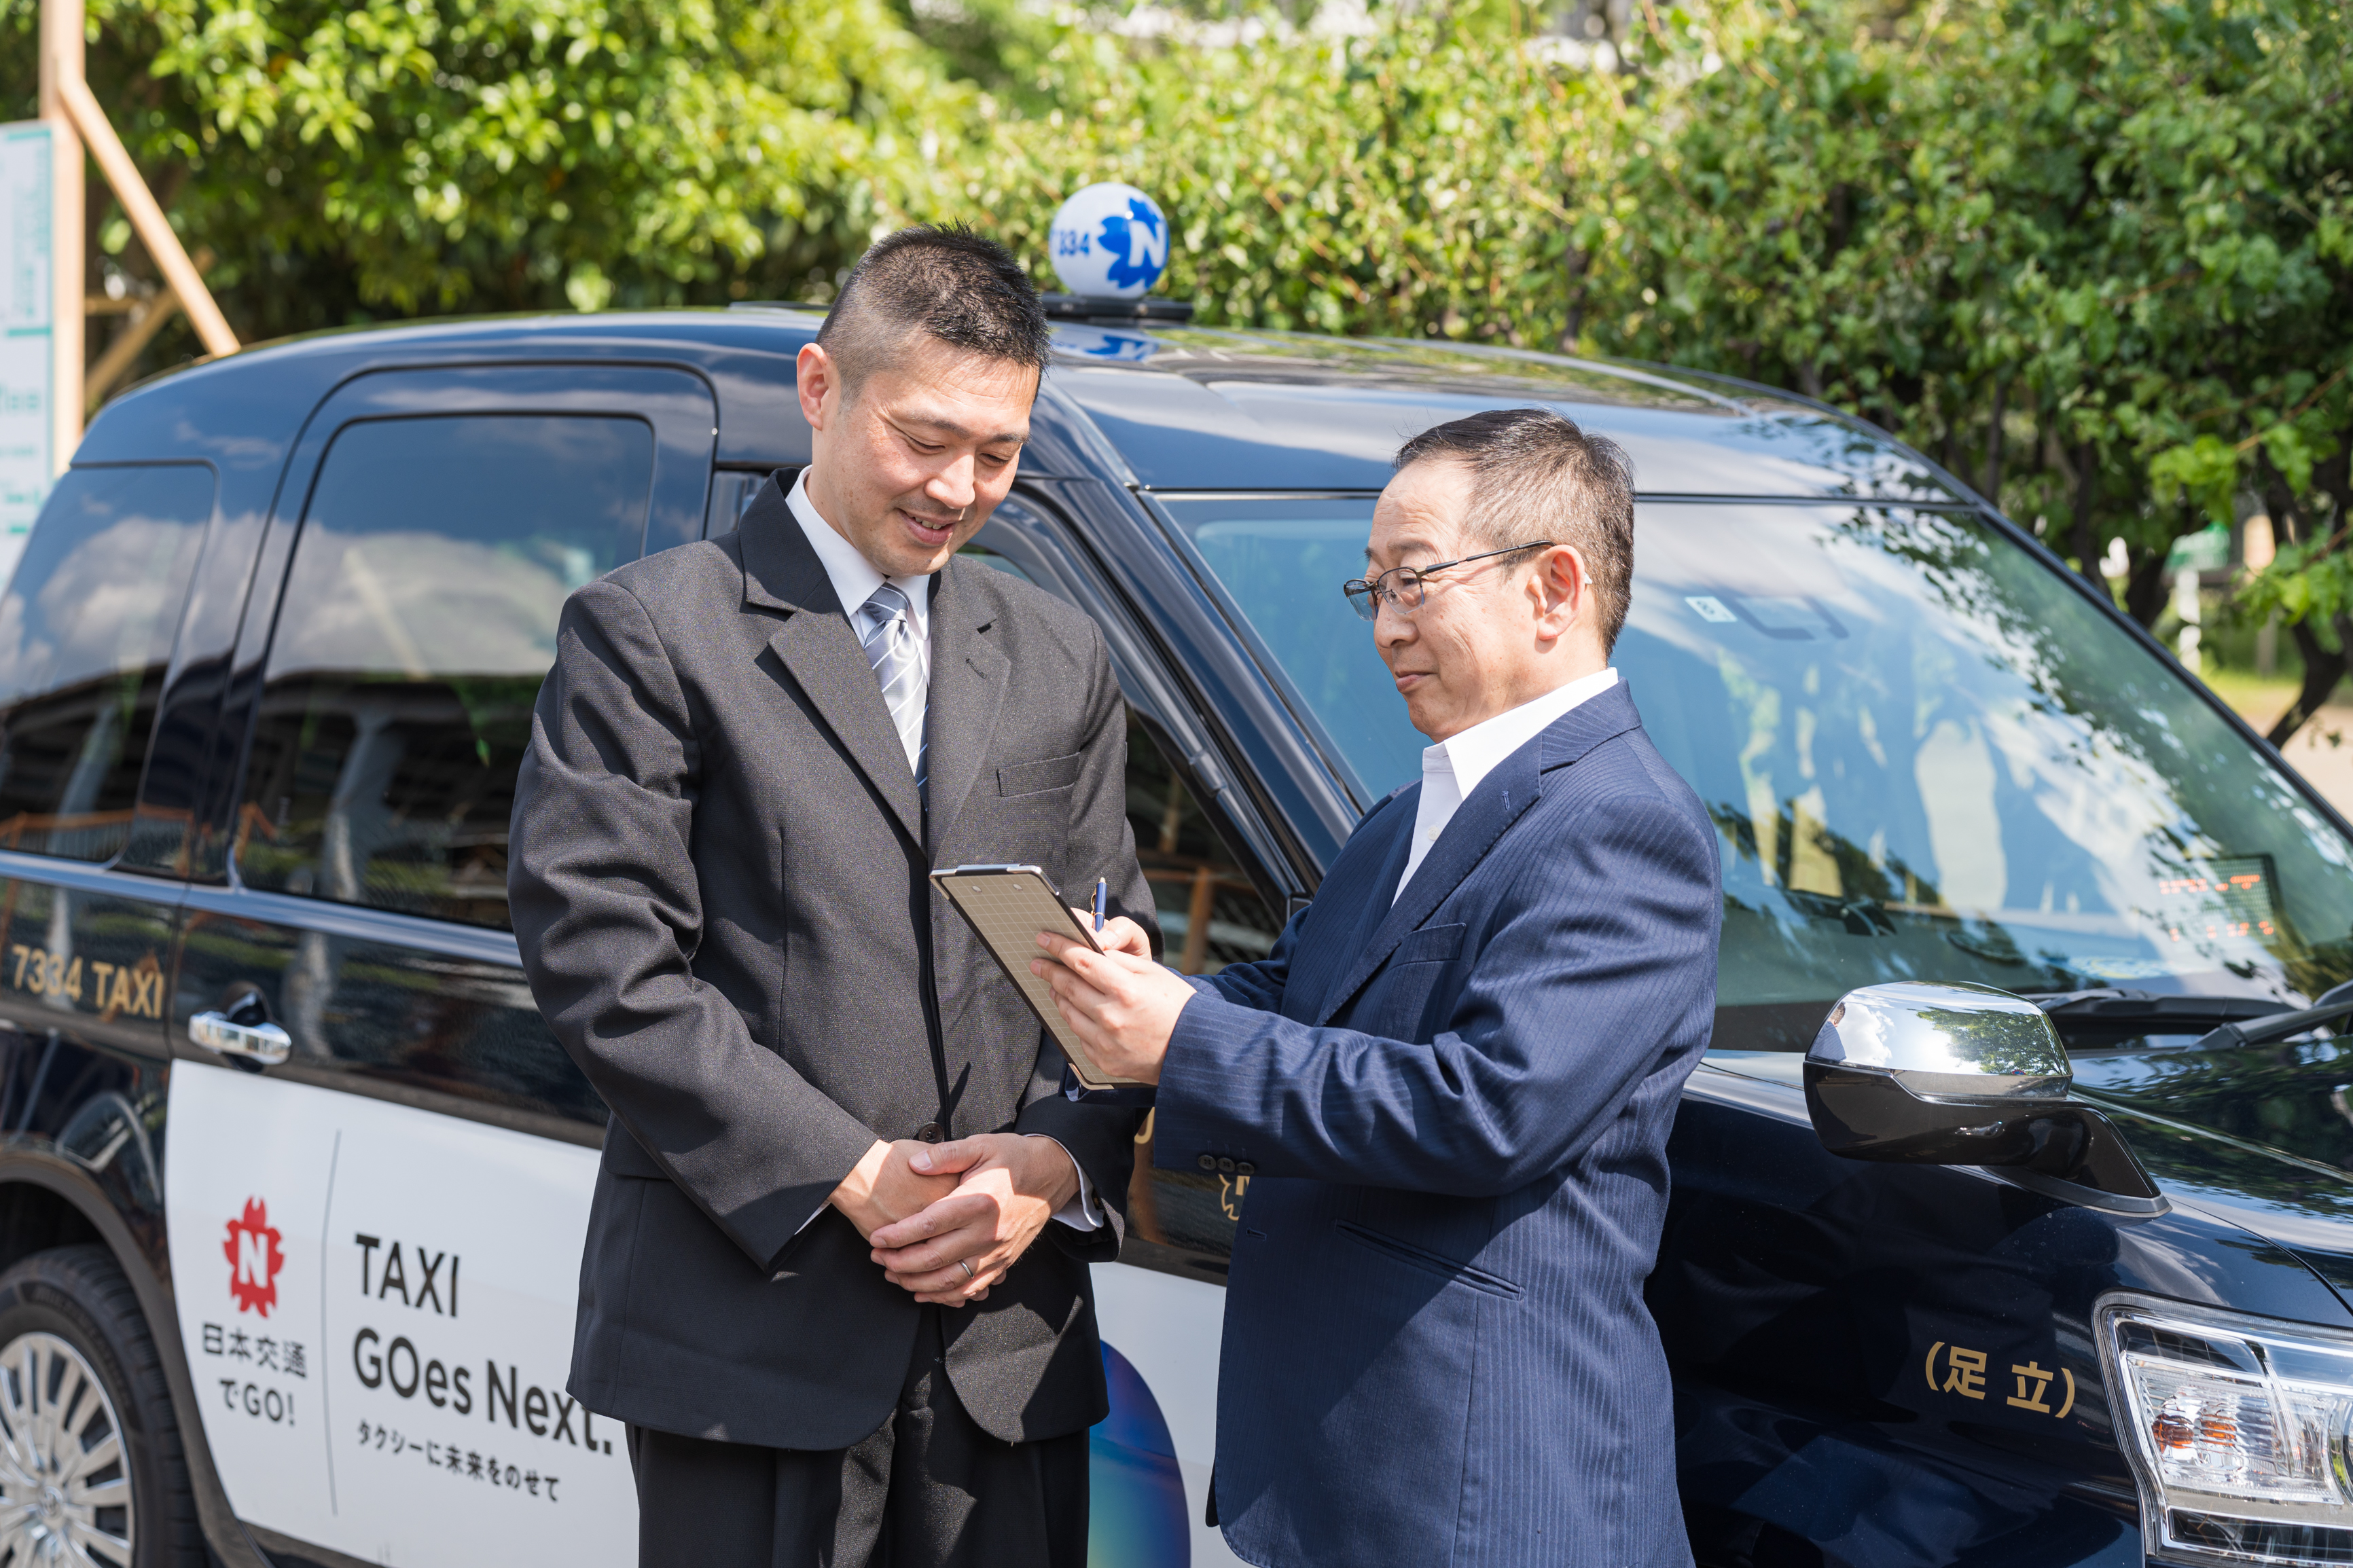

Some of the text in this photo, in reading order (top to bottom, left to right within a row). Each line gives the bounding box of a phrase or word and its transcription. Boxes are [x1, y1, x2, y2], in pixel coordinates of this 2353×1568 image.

[12, 943, 164, 1019] 7334 TAXI
[238, 1227, 268, 1289] N
[355, 1233, 460, 1318] TAXI
[202, 1322, 306, 1379] 日本交通
[353, 1327, 612, 1455] GOes Next.
[357, 1418, 560, 1503] タクシーに未来をのせて
